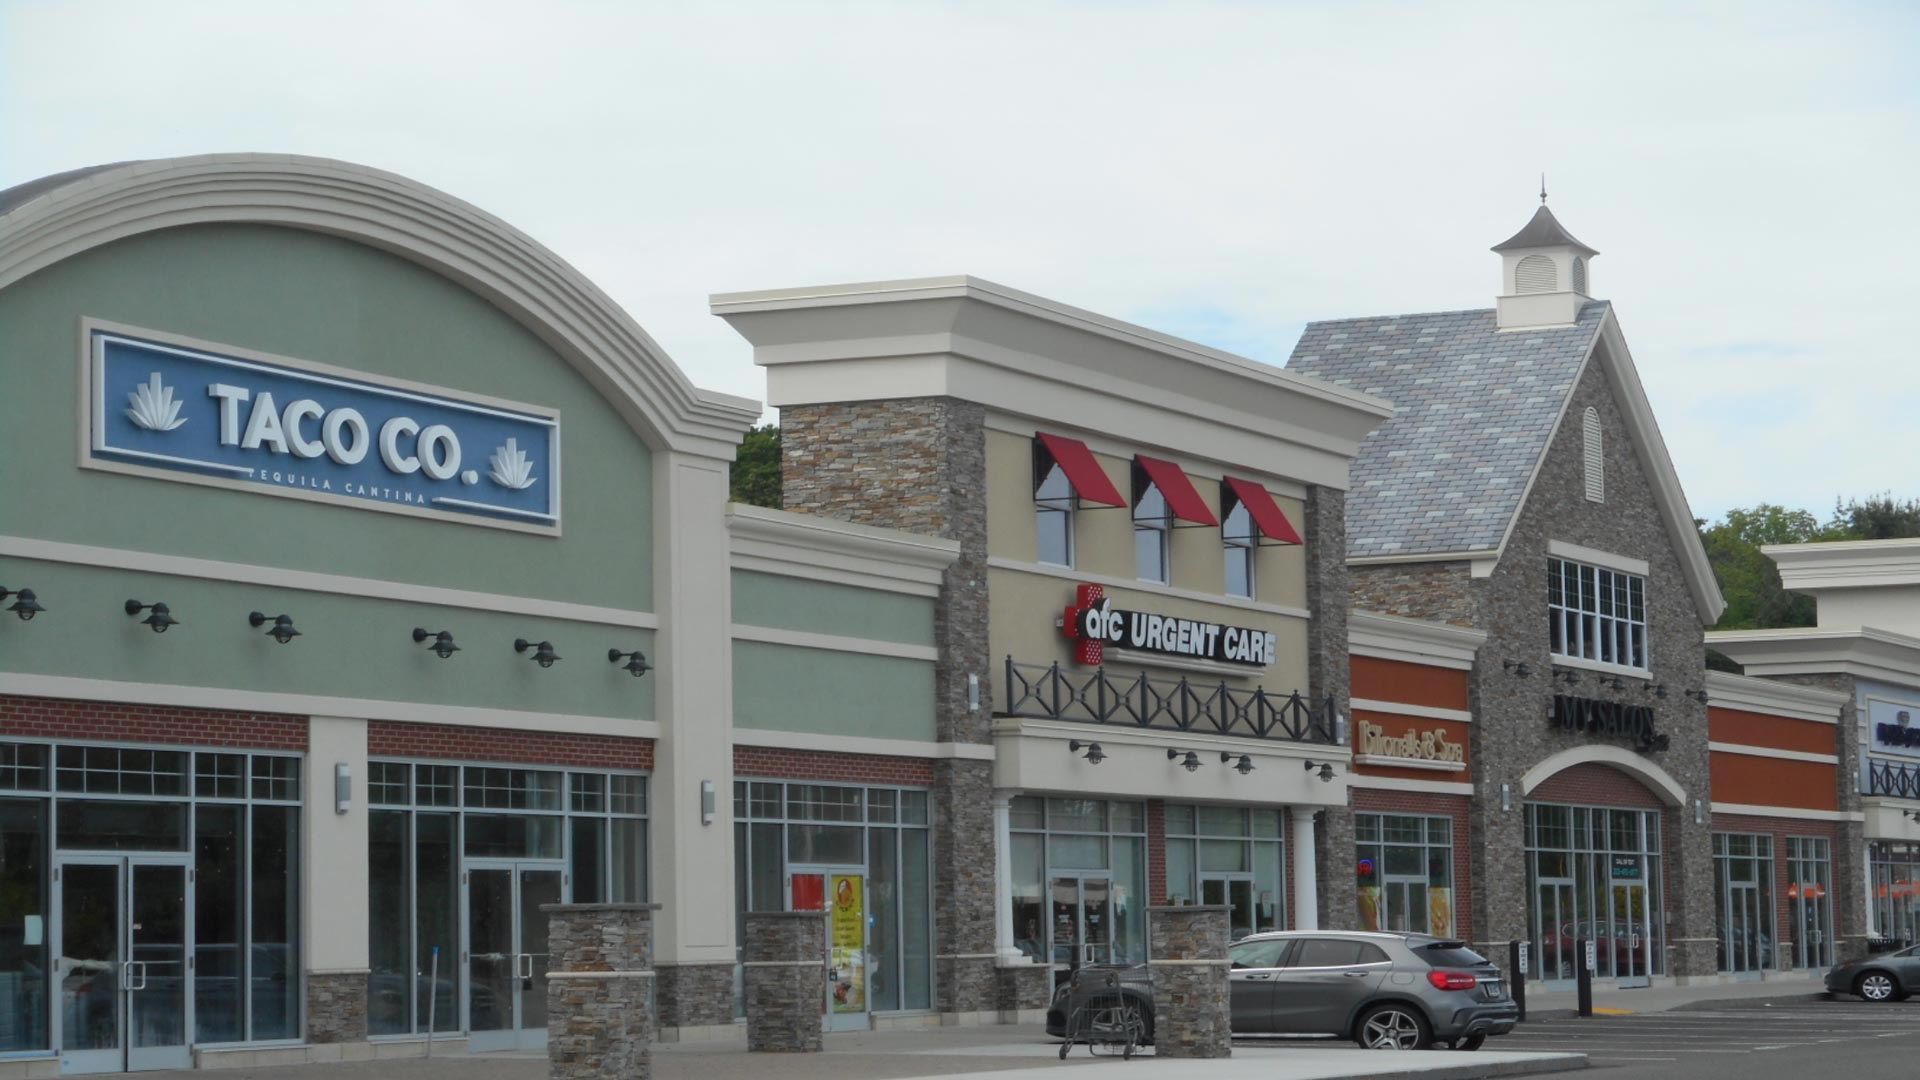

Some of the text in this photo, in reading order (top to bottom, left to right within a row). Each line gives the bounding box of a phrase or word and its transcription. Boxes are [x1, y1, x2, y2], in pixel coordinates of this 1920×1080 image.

[208, 383, 479, 486] TACO CO.
[248, 468, 425, 504] TEQUILA CANTINA
[1086, 597, 1276, 665] afc URGENT CARE
